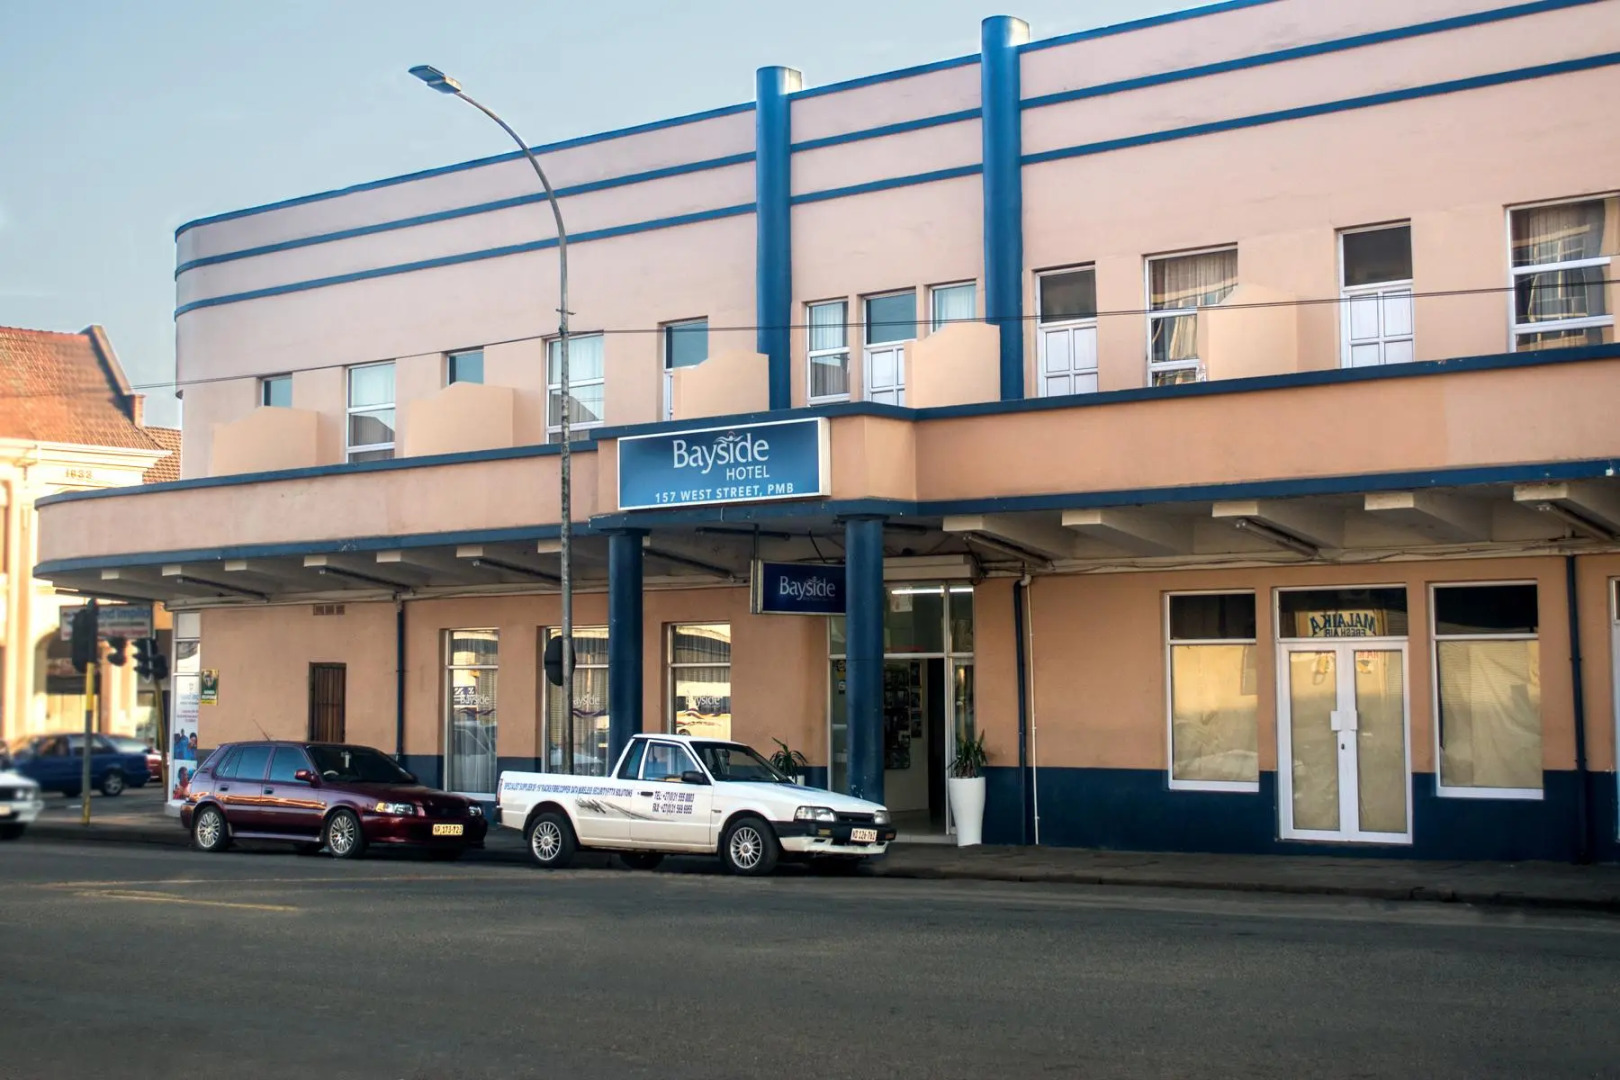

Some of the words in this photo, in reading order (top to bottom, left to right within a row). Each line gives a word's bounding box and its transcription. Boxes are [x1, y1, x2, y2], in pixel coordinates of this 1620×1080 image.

[673, 433, 769, 474] Bayside
[726, 465, 769, 481] HOTEL
[655, 491, 676, 503] 157
[681, 488, 711, 502] WEST
[716, 485, 763, 499] STREET,
[767, 483, 794, 495] PMB
[779, 576, 836, 601] Bayside
[573, 694, 600, 707] ayside
